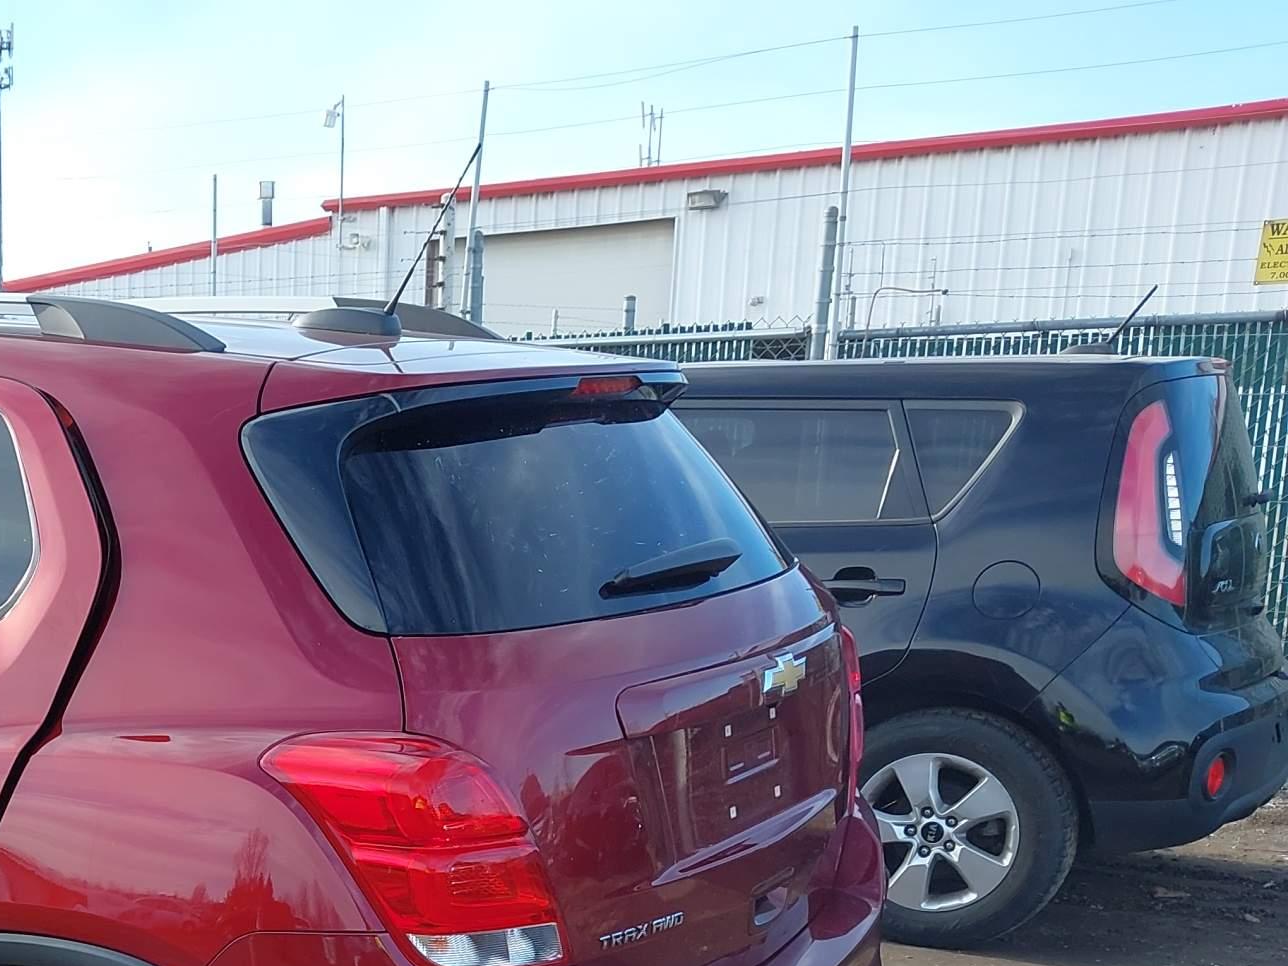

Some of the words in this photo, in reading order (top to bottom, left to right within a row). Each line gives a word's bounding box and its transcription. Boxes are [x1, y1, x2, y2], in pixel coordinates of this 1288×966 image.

[1260, 260, 1288, 270] ELEC
[599, 922, 649, 950] TRAX
[652, 911, 685, 935] AWD
